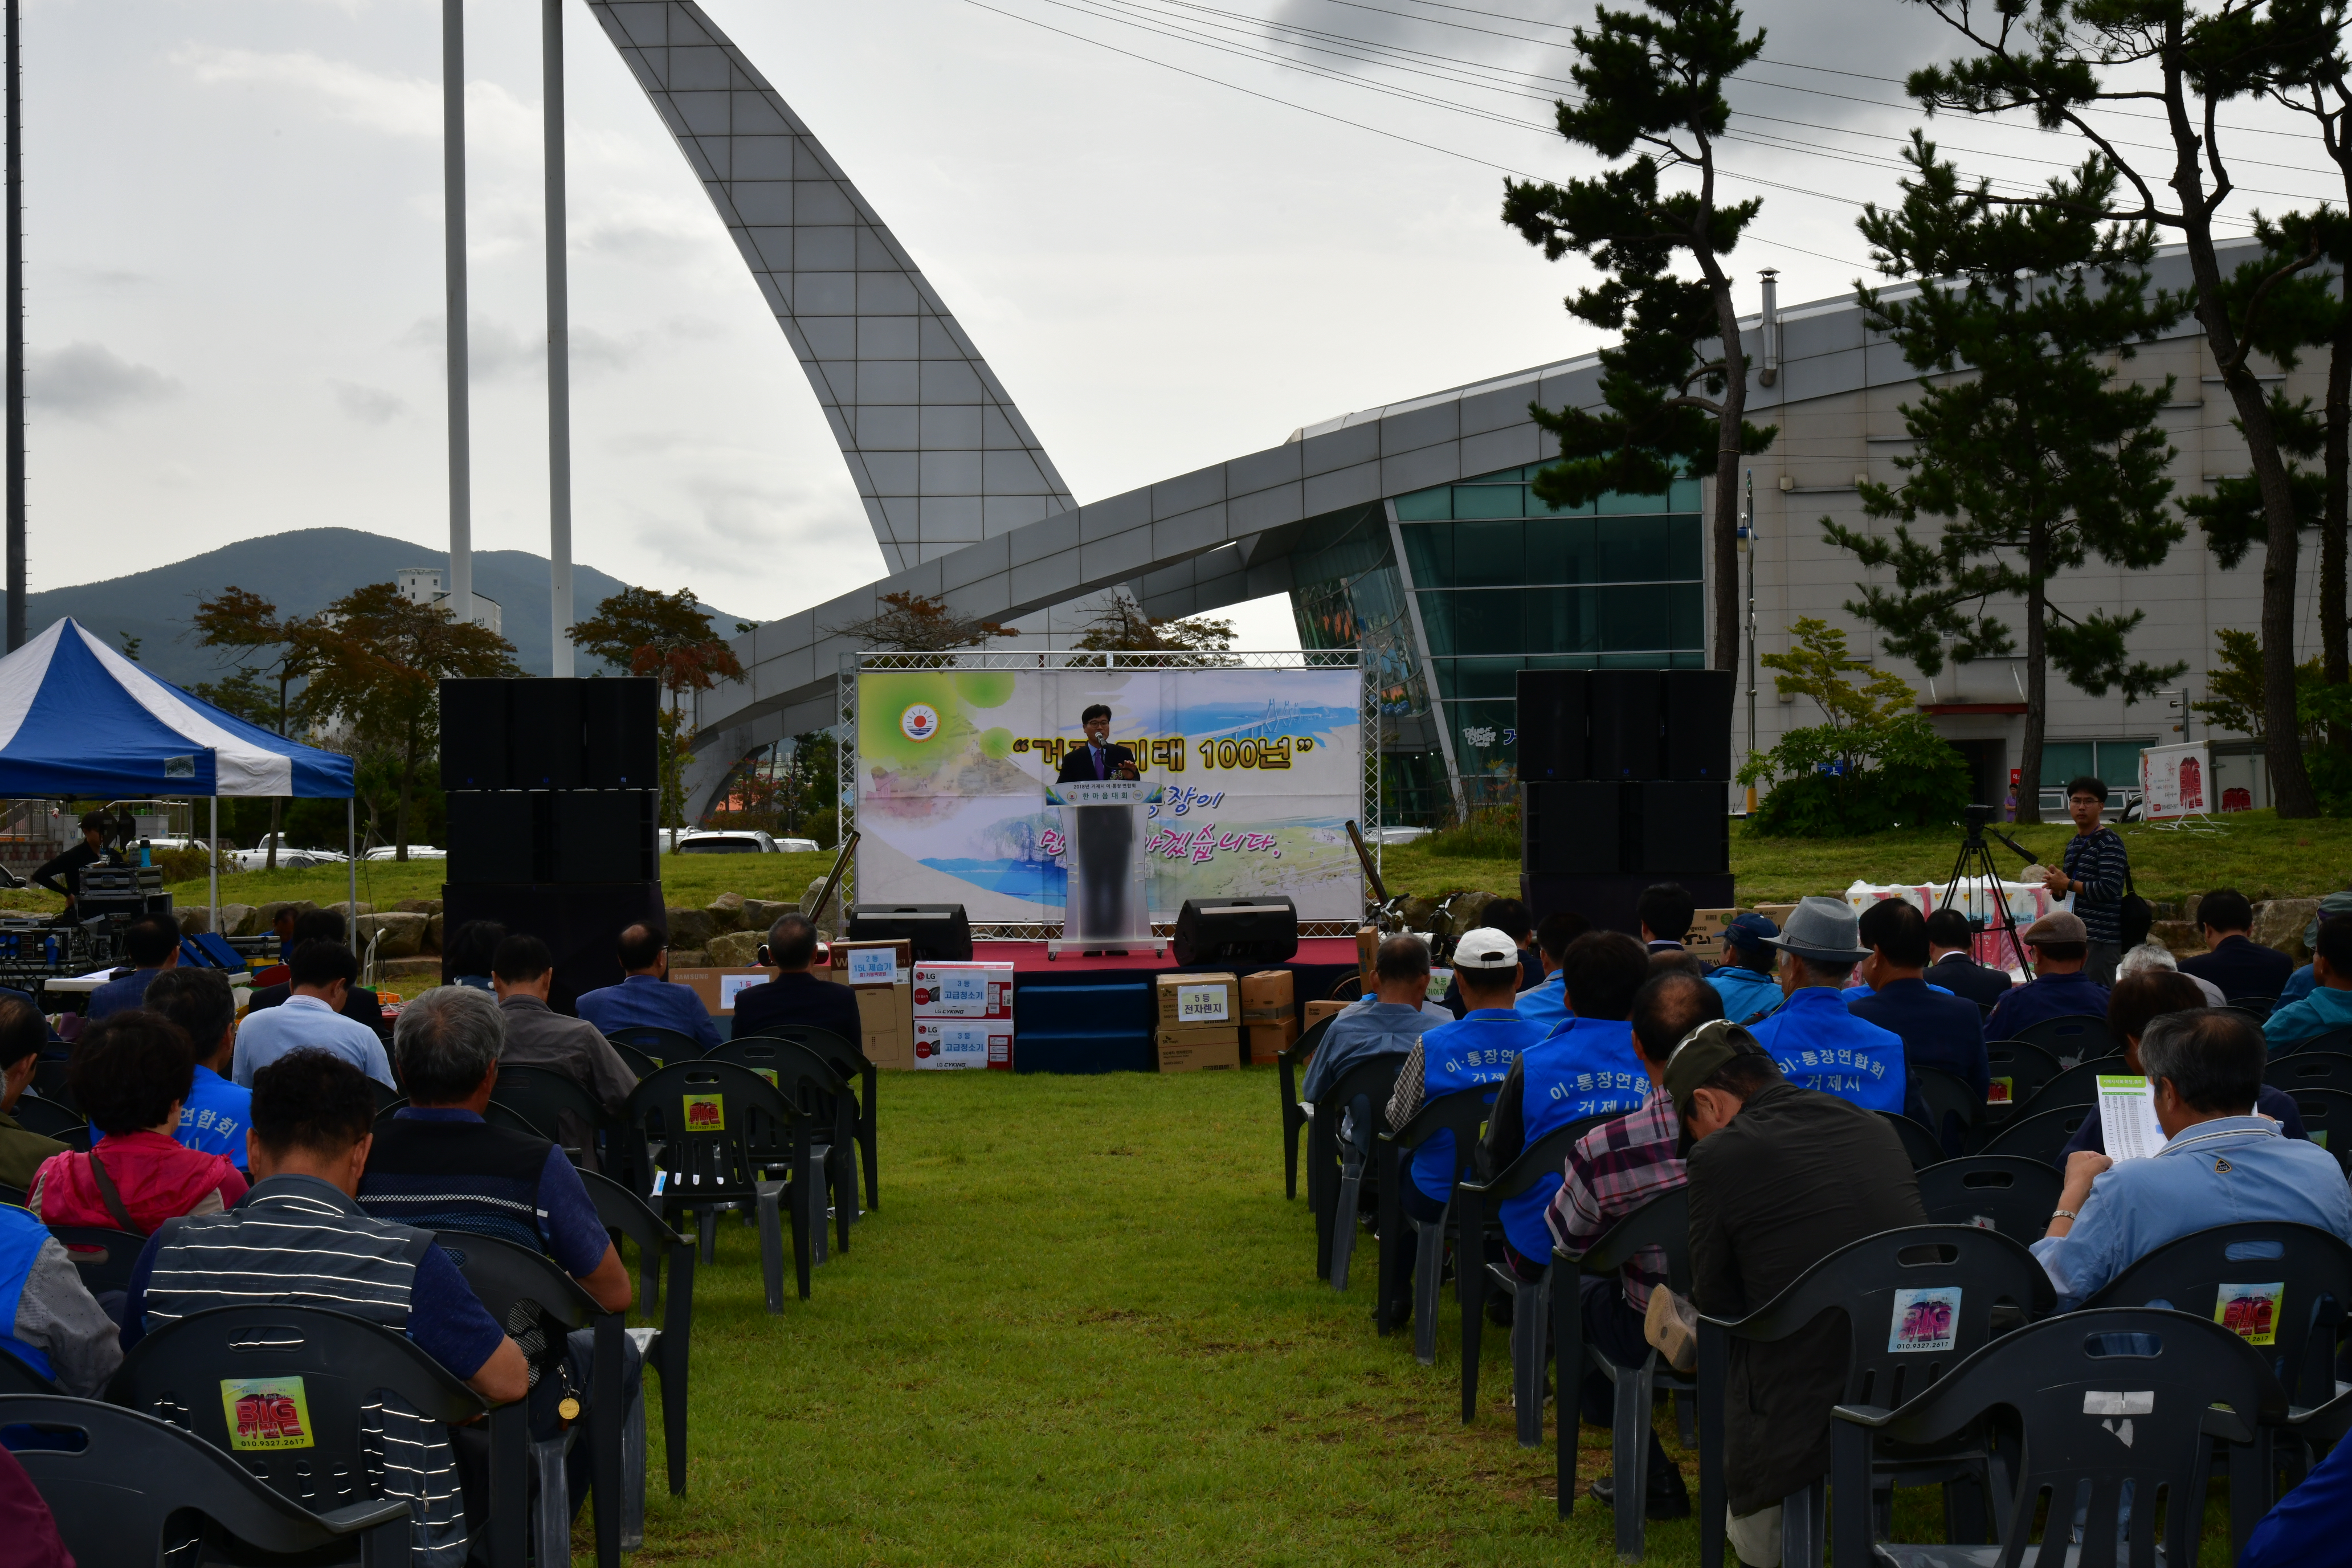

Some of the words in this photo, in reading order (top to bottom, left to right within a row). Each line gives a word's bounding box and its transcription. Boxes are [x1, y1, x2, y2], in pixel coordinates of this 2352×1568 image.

[2179, 763, 2201, 789] BIG
[2223, 790, 2251, 803] BIG
[869, 962, 891, 971] 제습기
[1440, 977, 1447, 986] 등
[944, 991, 983, 999] 고급청소기
[1202, 994, 1210, 1002] 등
[1185, 1003, 1222, 1014] 전자렌지
[945, 1043, 983, 1052] 고급청소기
[1806, 1074, 1860, 1092] 거제시
[689, 1105, 718, 1117] BIG
[1902, 1306, 1952, 1328] BIG
[2224, 1301, 2273, 1322] BIG
[235, 1399, 298, 1423] BIG
[237, 1420, 305, 1440] 이벤트
